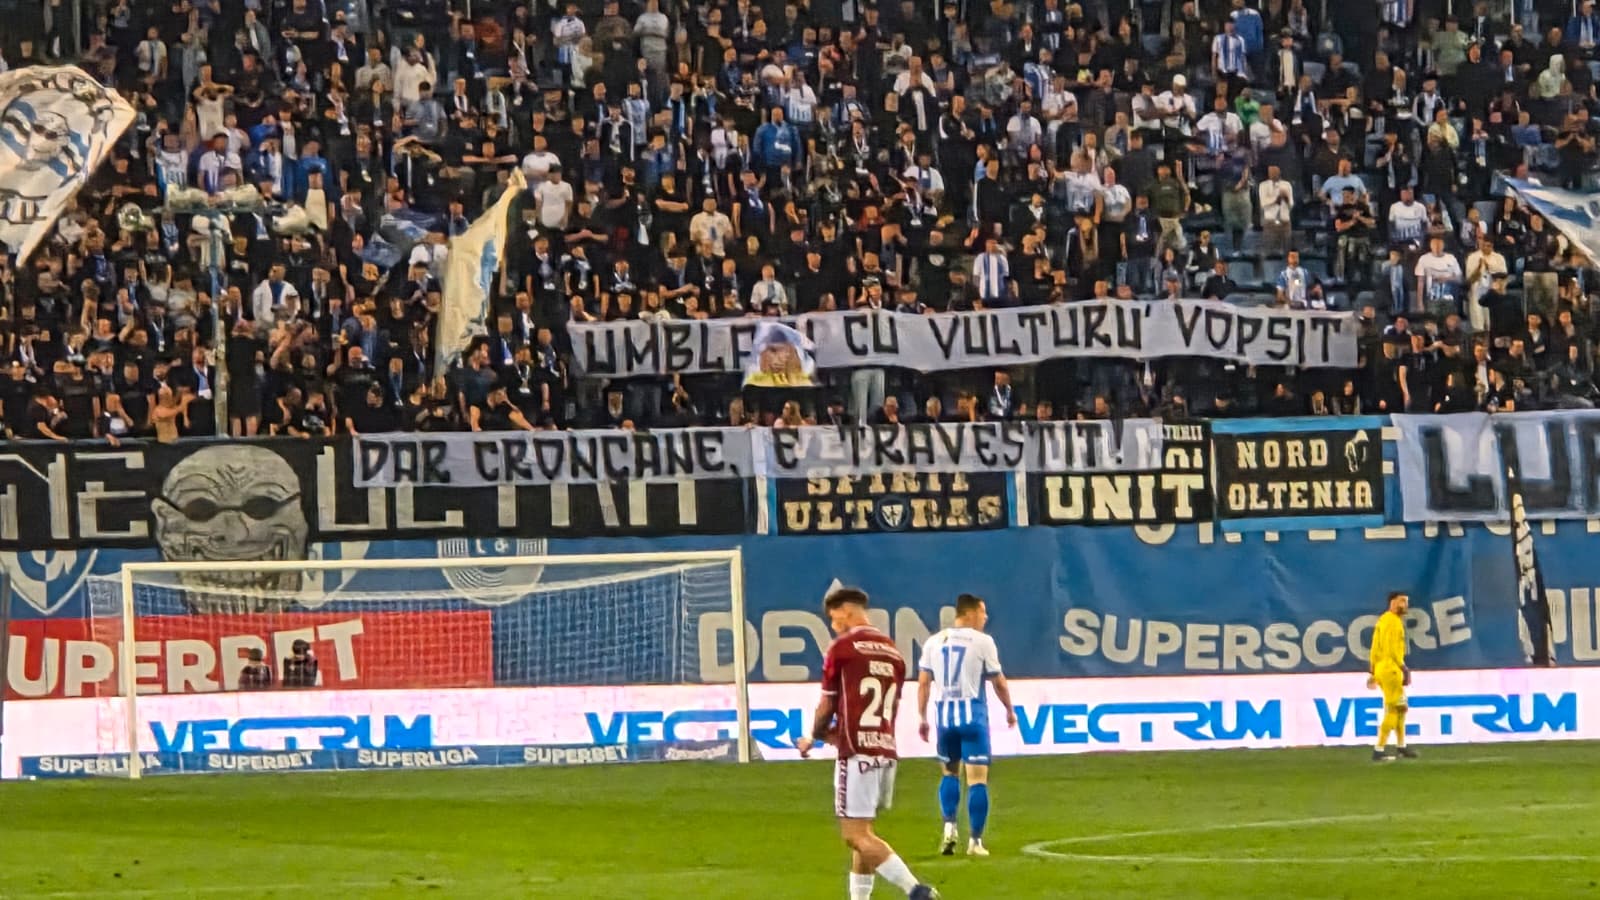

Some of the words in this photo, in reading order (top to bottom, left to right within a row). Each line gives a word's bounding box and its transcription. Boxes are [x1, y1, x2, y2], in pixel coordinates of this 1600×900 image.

[843, 313, 899, 355] CU
[928, 303, 1151, 360] VULTURU'
[1174, 303, 1341, 364] VOPSIT
[358, 438, 451, 484] DAR
[1236, 438, 1328, 469] NORD
[1045, 474, 1204, 520] UNIT
[1228, 480, 1373, 511] OLTENIA
[941, 645, 967, 687] 17
[150, 714, 435, 752] VECTRUM
[584, 708, 838, 750] VECTRU
[1015, 699, 1282, 745] VECTRUM
[38, 755, 162, 774] SUPERLIA
[208, 749, 313, 769] SUPERBET
[357, 746, 479, 767] SUPERLIGA
[522, 744, 629, 765] SUPERBET
